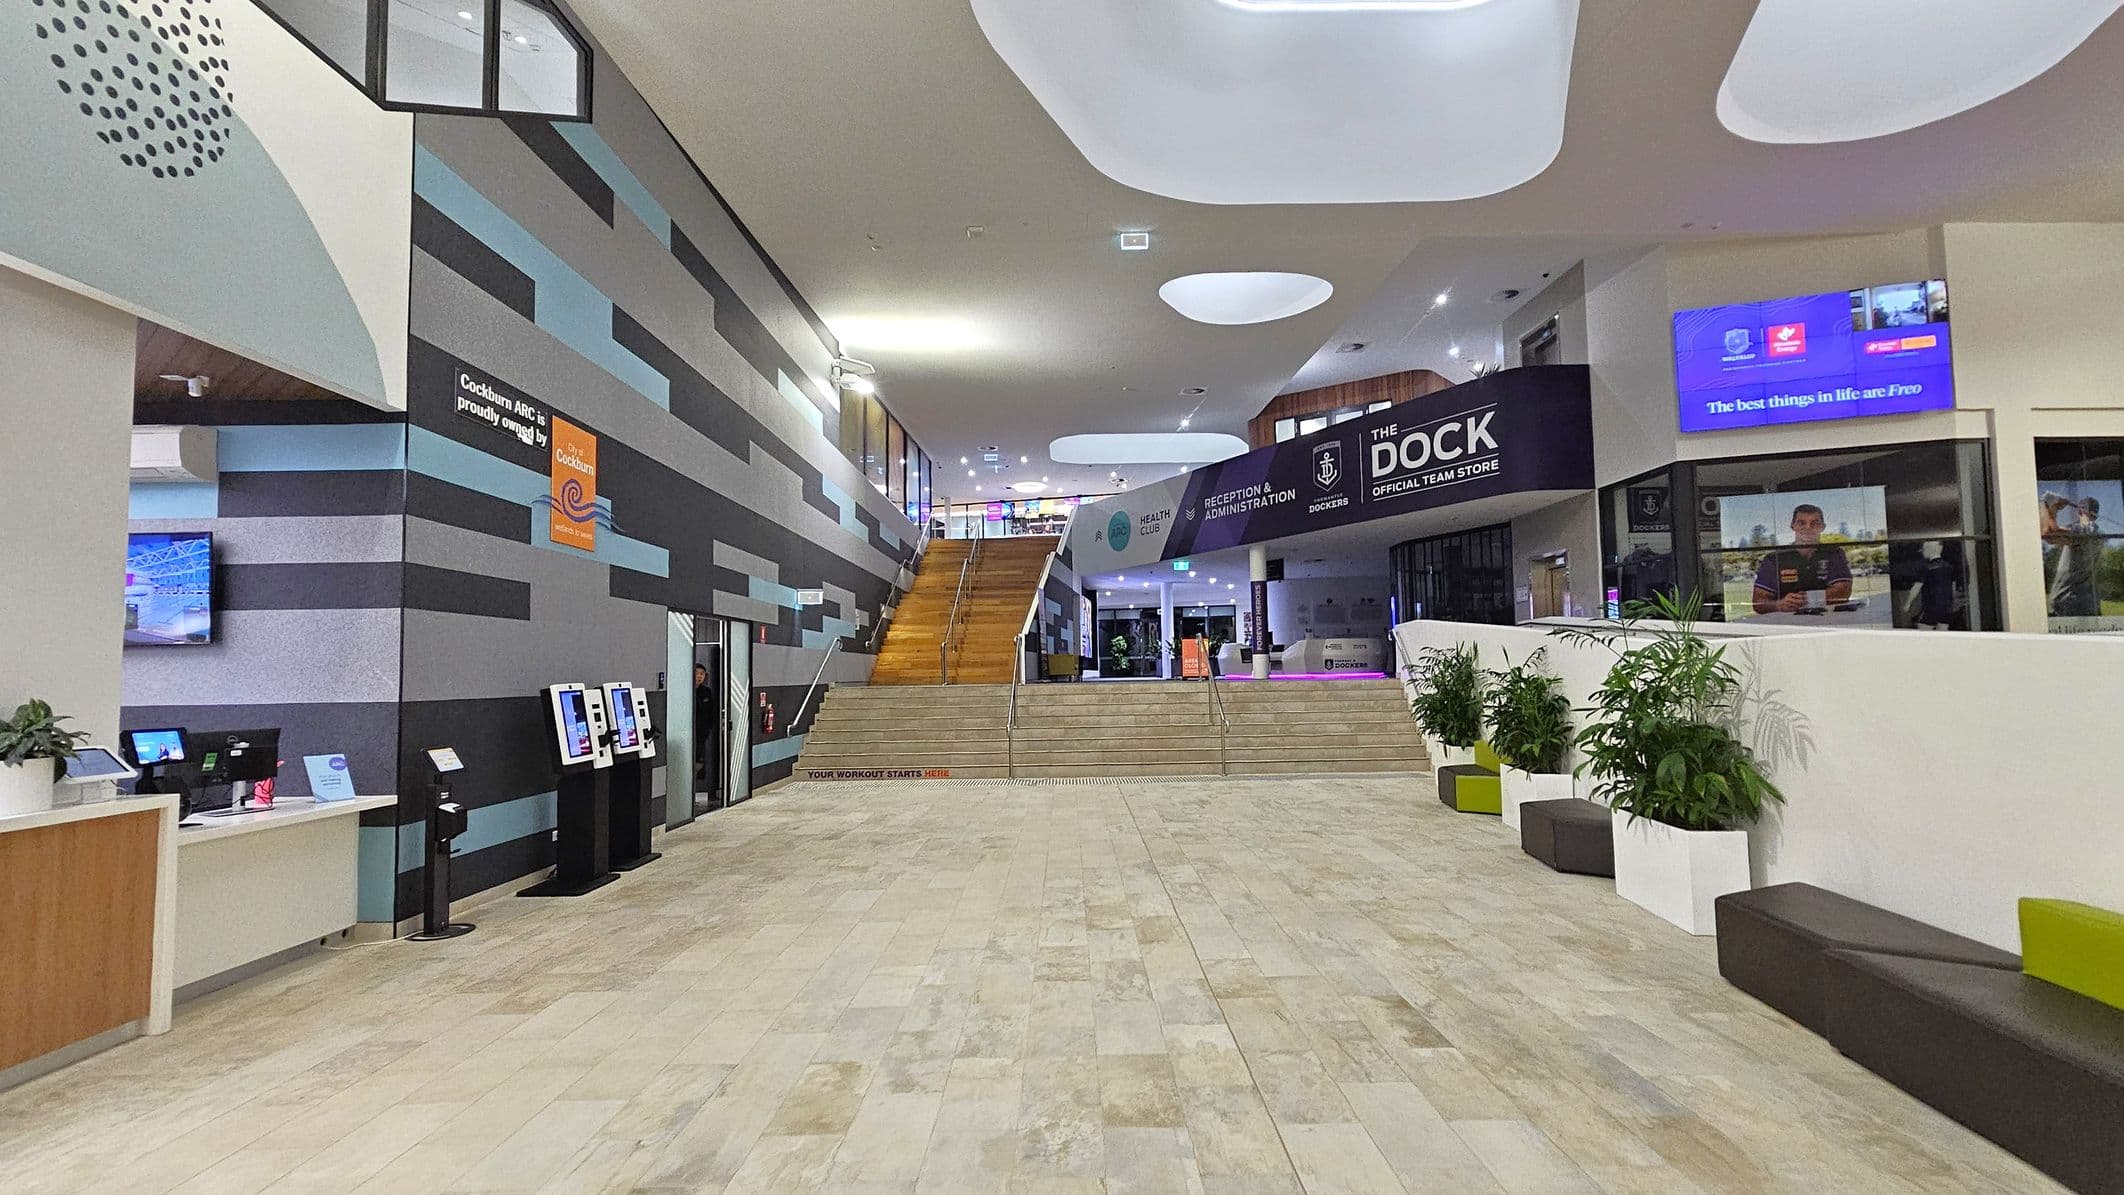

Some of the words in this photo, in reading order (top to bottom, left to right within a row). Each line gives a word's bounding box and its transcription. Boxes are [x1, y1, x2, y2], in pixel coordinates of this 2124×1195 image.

[460, 373, 512, 411] Cockburn
[514, 400, 535, 421] ARC
[537, 410, 546, 426] is
[1706, 400, 1734, 414] The
[1736, 398, 1765, 412] best
[1768, 393, 1815, 408] things
[1817, 390, 1833, 403] in
[1835, 387, 1861, 401] life
[1862, 386, 1886, 399] are
[1887, 383, 1923, 397] Freo
[457, 396, 500, 426] proudly
[501, 417, 534, 441] owned
[536, 428, 548, 447] by
[1371, 423, 1398, 441] THE
[1371, 411, 1499, 478] DOCK
[556, 448, 594, 477] Cockburn
[1372, 477, 1420, 497] OFFICIAL
[1422, 468, 1455, 486] TEAM
[1457, 459, 1500, 478] STORE
[1204, 486, 1261, 509] RECEPTION
[1263, 481, 1272, 493] &
[1204, 488, 1296, 521] ADMINISTRATION
[1309, 497, 1349, 514] DOCKERS
[1140, 509, 1170, 525] HEALTH
[1140, 523, 1160, 536] CLUB
[1633, 524, 1671, 532] DOCKERS
[807, 770, 834, 779] YOUR
[836, 770, 885, 779] WORKOUT
[887, 769, 922, 778] STARTS
[924, 769, 950, 778] HERE
